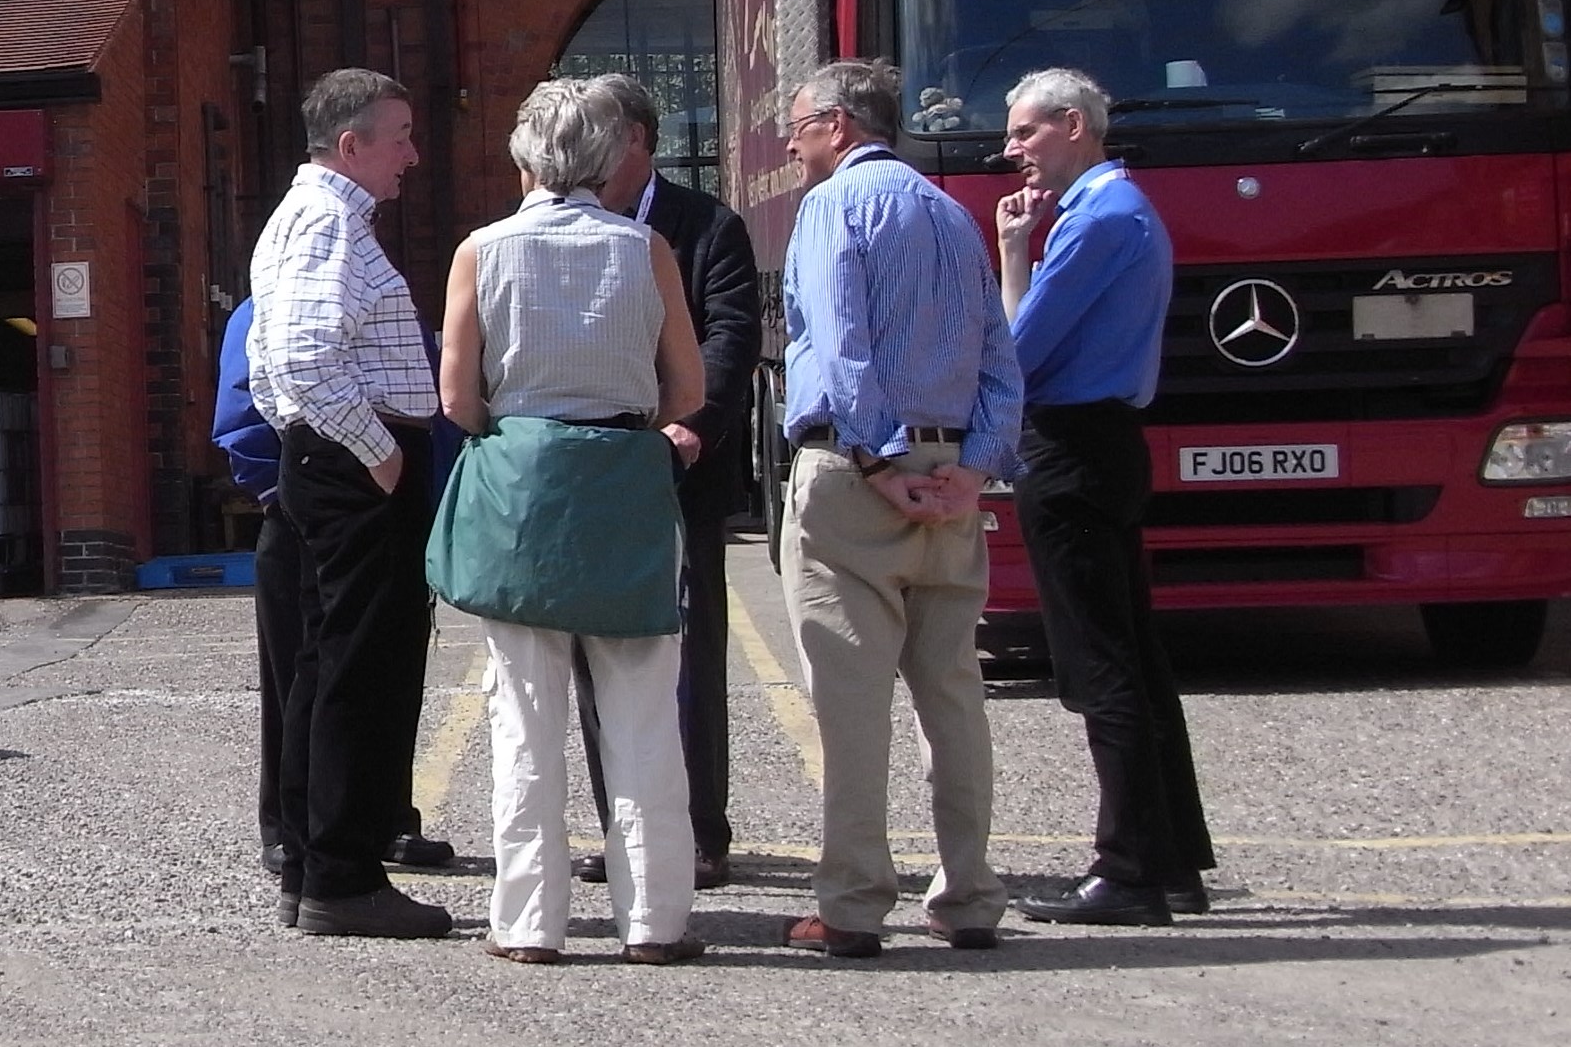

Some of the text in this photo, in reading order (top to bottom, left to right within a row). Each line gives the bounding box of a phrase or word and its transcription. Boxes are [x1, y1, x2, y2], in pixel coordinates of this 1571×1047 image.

[1372, 269, 1513, 290] ACTROS
[1192, 449, 1326, 476] FJ06 RXO
